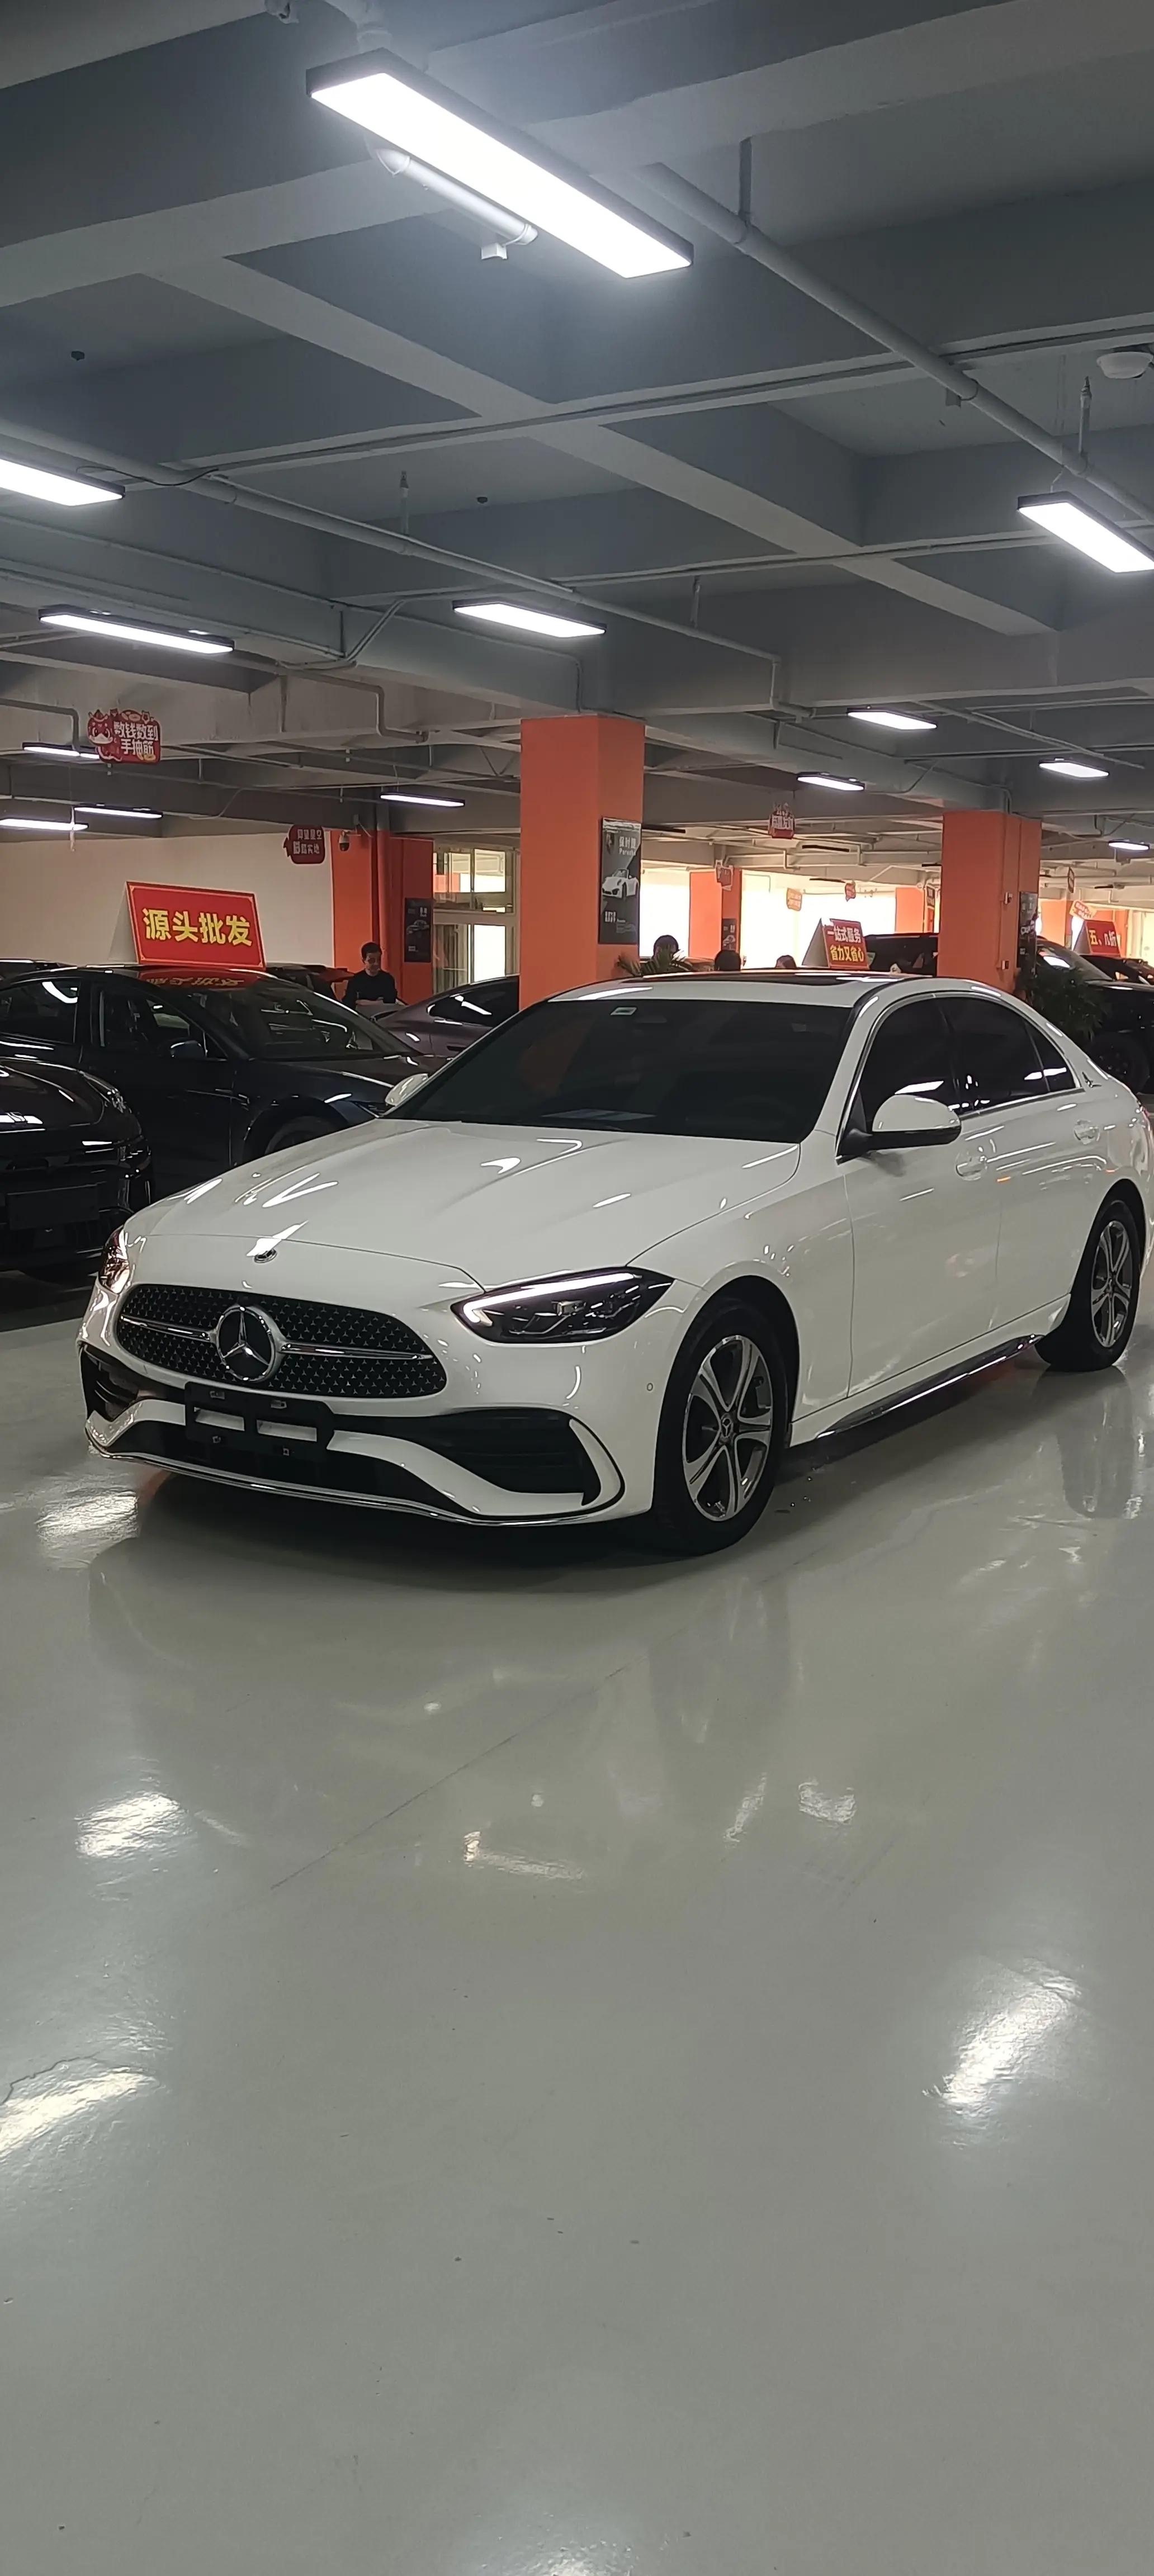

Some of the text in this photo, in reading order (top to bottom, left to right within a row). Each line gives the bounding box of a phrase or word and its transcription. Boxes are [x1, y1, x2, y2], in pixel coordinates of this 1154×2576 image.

[113, 721, 158, 741] 数钱数到
[121, 738, 154, 755] 手抽筋
[142, 908, 252, 946] 源头批发
[827, 925, 861, 943] 一站式服务
[830, 944, 864, 962] 省力又省心
